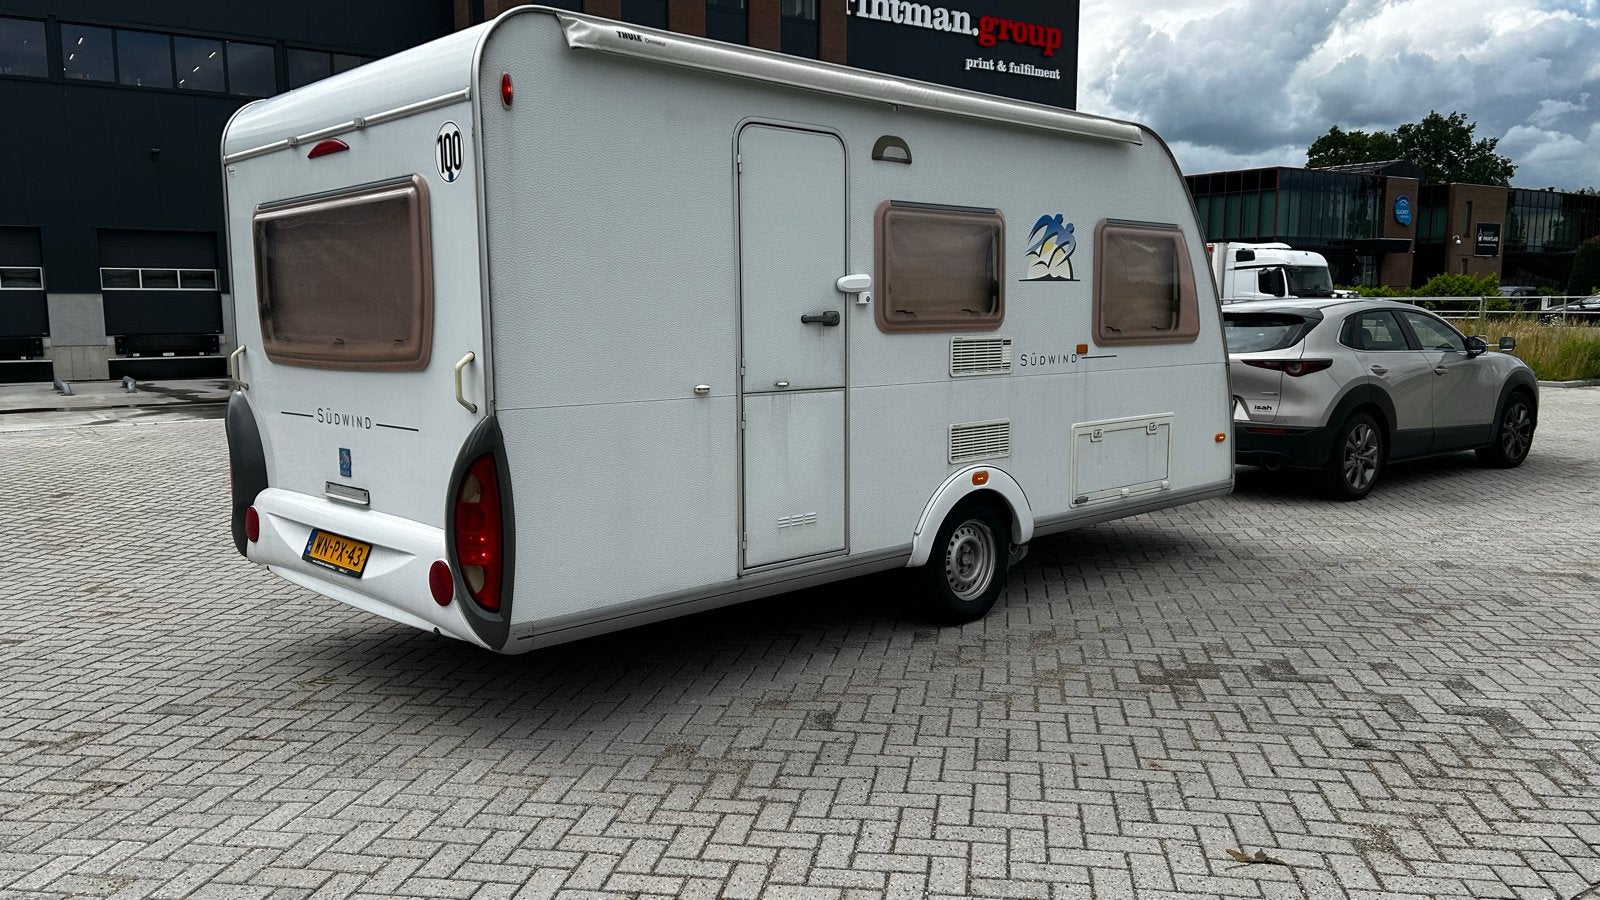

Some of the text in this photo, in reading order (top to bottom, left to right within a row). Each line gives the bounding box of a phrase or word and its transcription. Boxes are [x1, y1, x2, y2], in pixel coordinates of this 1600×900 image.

[616, 30, 642, 42] THULE
[965, 57, 1061, 80] print & fulfilment
[437, 130, 462, 173] 100
[1020, 352, 1078, 367] SÜDWIND
[317, 407, 373, 430] SÜDWIND
[314, 535, 364, 567] WN-PX-43
